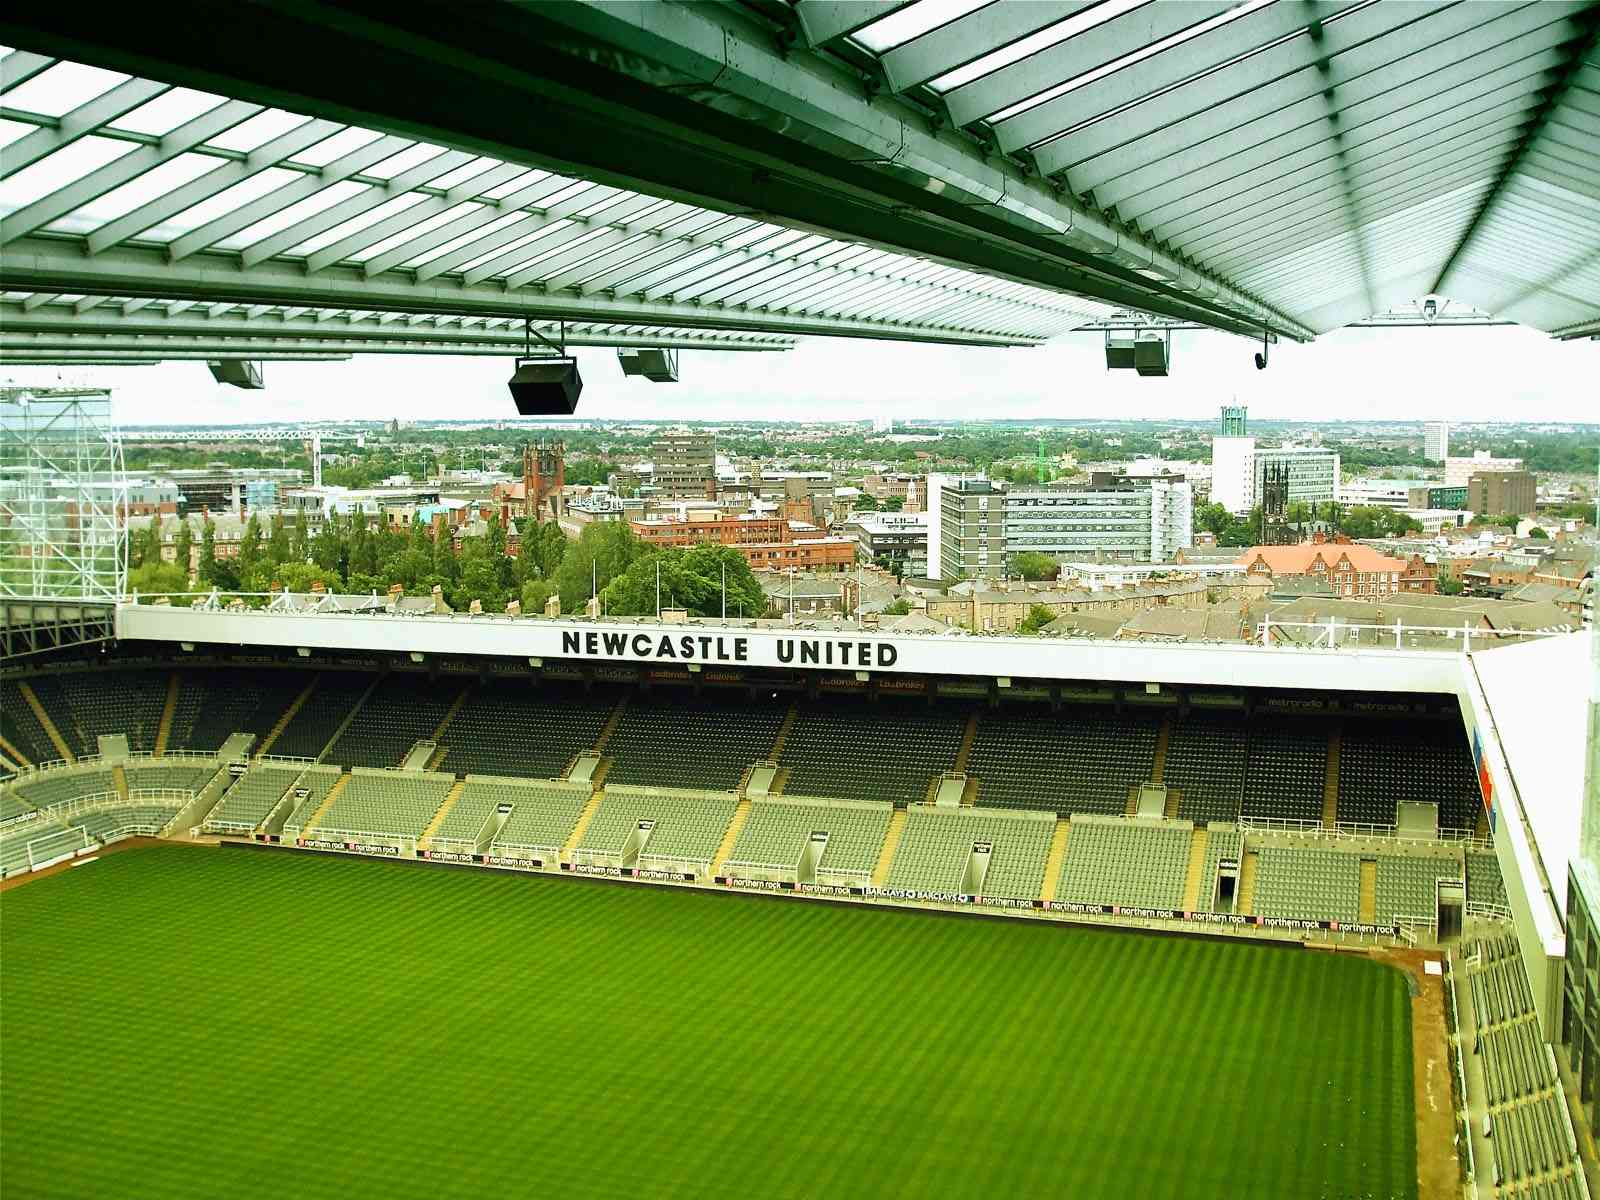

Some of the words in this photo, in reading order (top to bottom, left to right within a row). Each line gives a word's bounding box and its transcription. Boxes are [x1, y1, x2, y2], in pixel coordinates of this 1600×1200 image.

[562, 631, 748, 661] NEWCASTLE
[777, 639, 898, 667] UNITED
[304, 839, 330, 848] northern
[332, 842, 345, 850] rock
[355, 843, 382, 852] northern
[384, 846, 396, 854] rock
[431, 850, 457, 859] northern
[459, 853, 473, 861] rock
[489, 856, 516, 865] northern
[518, 859, 533, 867] rock
[576, 864, 604, 874] northern
[606, 867, 622, 876] rock
[639, 869, 667, 878] northern
[669, 871, 685, 880] rock
[733, 877, 763, 887] northern
[765, 880, 781, 889] rock
[834, 885, 850, 895] rock
[865, 887, 906, 898] BARCLAYS
[916, 892, 958, 902] BARCLAYS
[982, 896, 1015, 906] northern
[1017, 898, 1034, 907] rock
[1051, 901, 1084, 911] northern
[1085, 903, 1103, 913] rock
[1120, 906, 1154, 916] northern
[1156, 909, 1174, 918] rock
[1192, 911, 1227, 921] northern
[1228, 914, 1246, 923] rock
[1264, 916, 1300, 927] northern
[1301, 918, 1320, 929] rock
[1338, 921, 1374, 932] northern
[1375, 924, 1394, 934] rock
